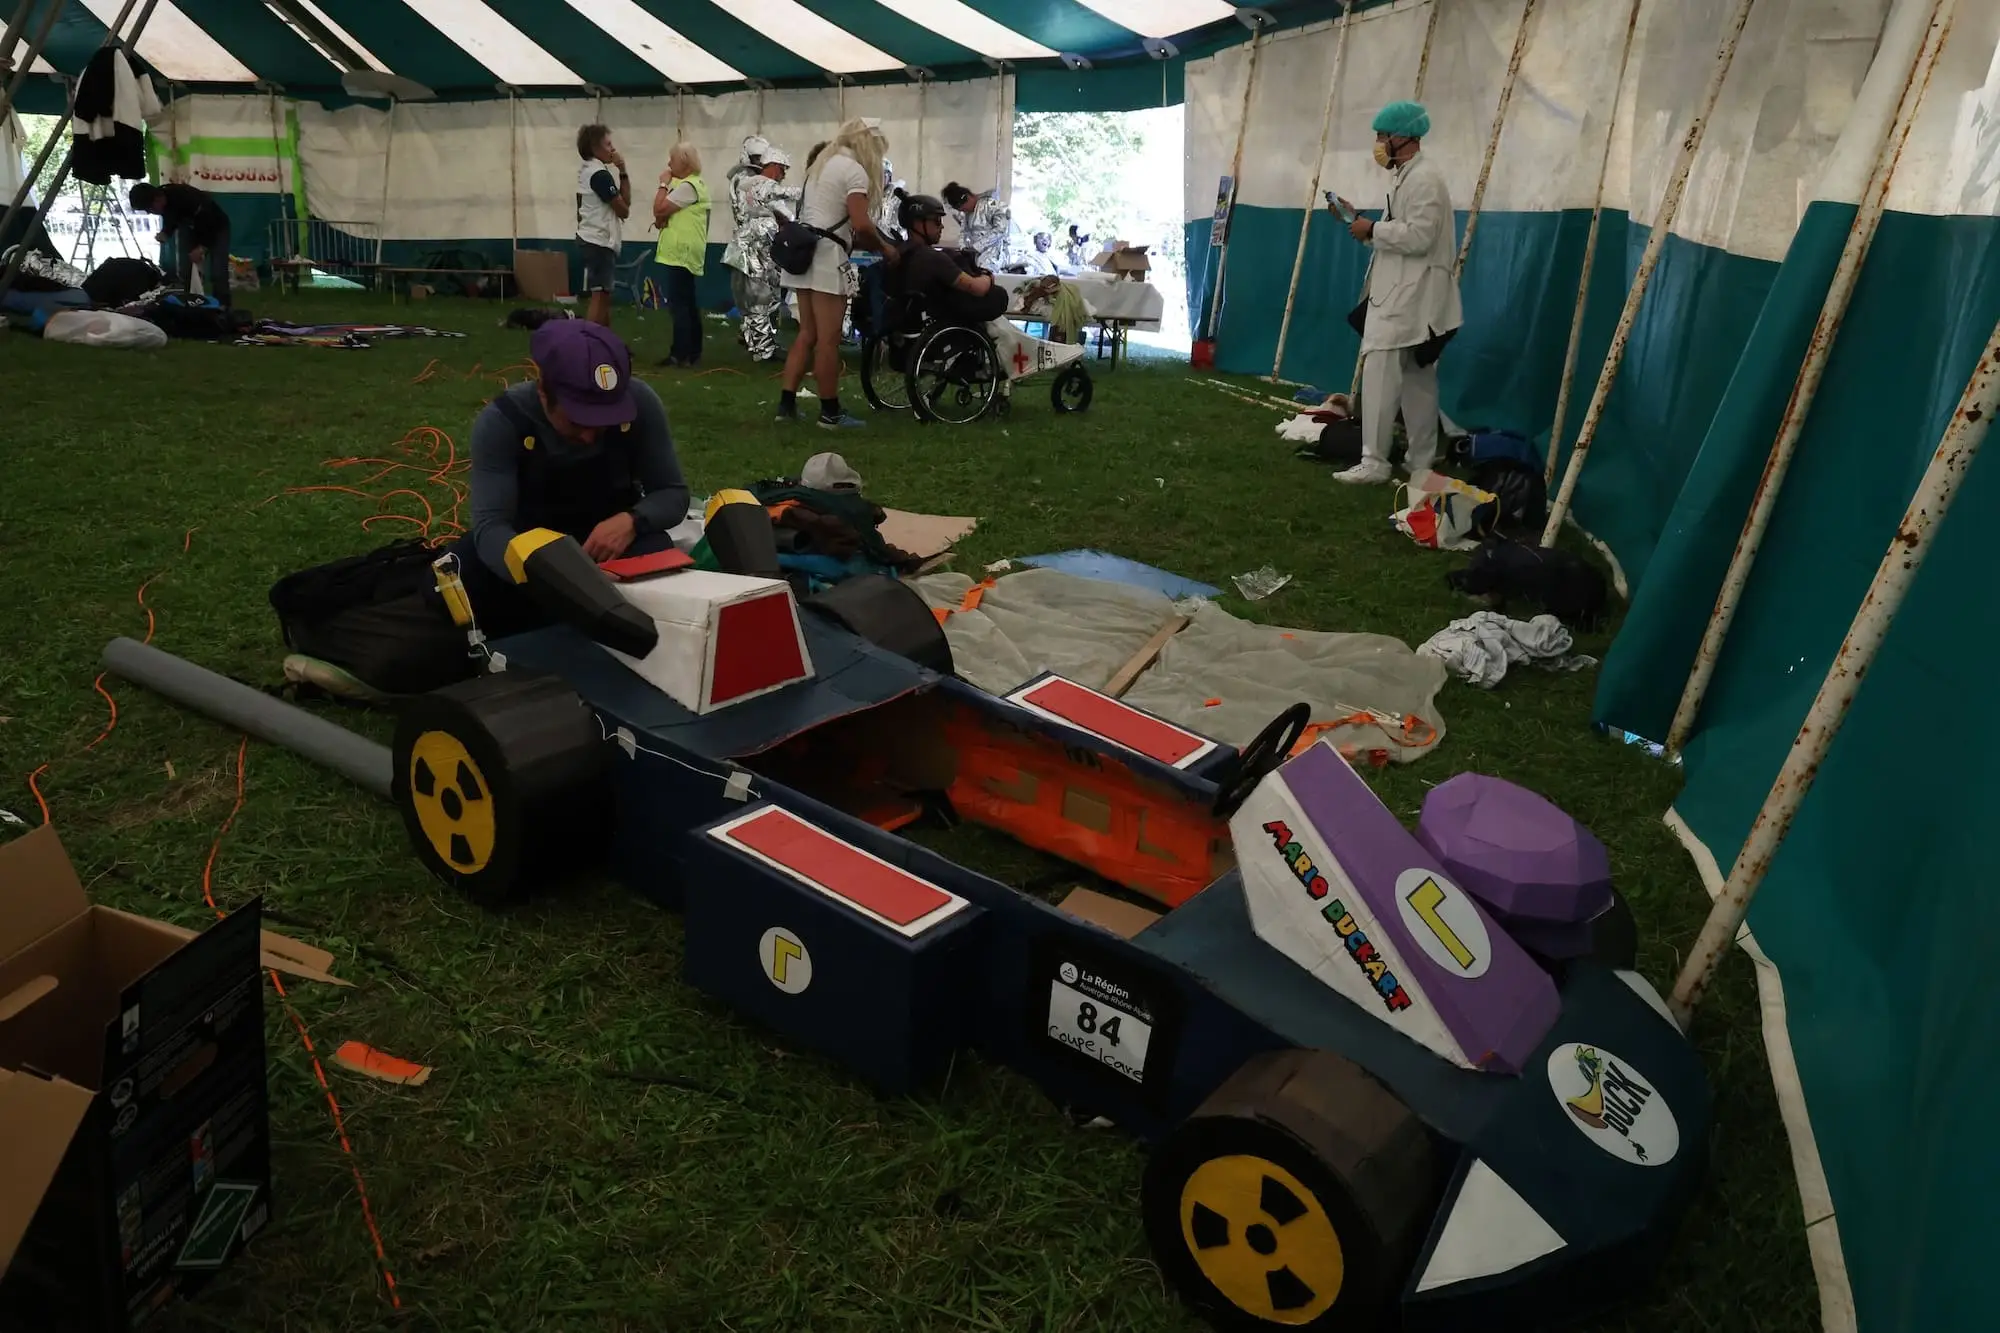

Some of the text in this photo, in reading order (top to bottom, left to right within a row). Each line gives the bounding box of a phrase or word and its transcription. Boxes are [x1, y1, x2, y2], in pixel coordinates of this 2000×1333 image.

[1263, 821, 1329, 900] MARIO
[1081, 969, 1129, 1000] La Région
[1077, 1002, 1122, 1047] 84
[1603, 1061, 1652, 1137] DUCK
